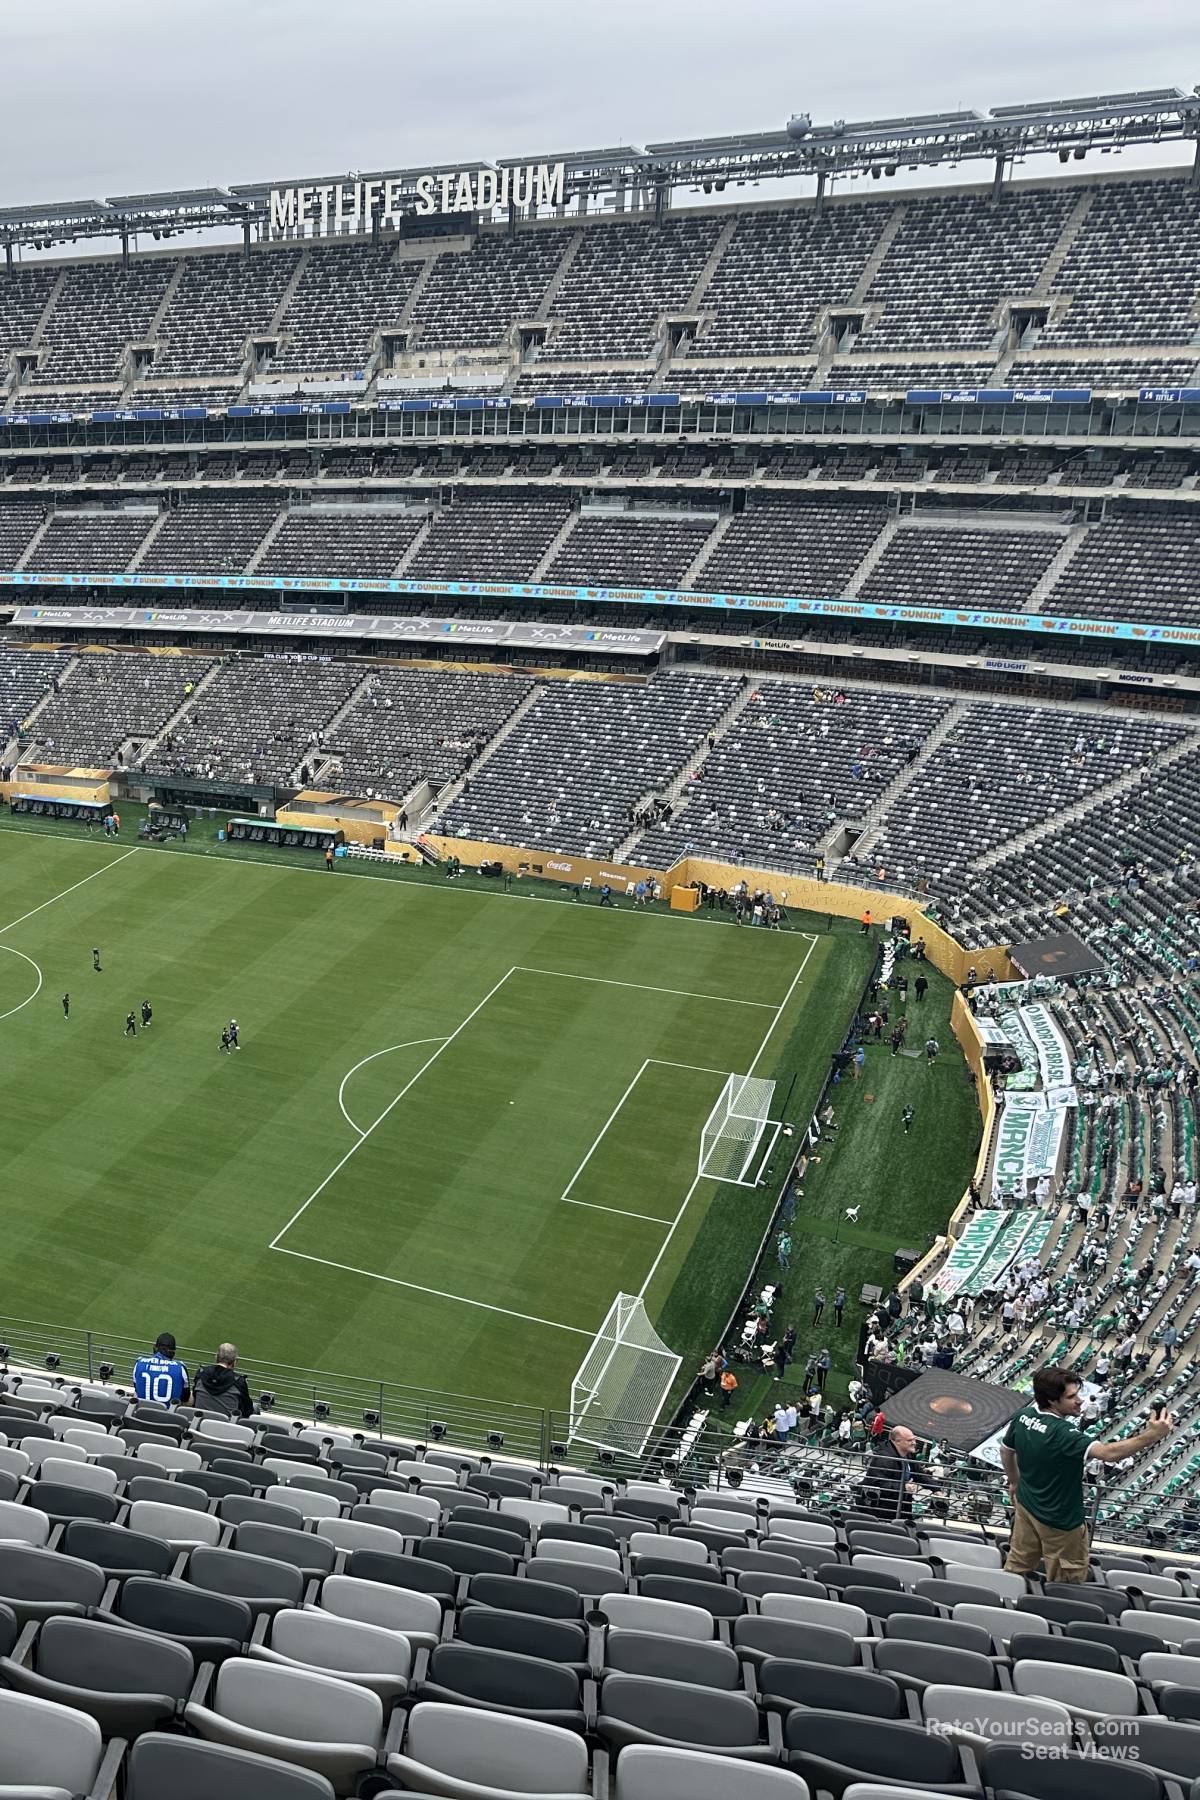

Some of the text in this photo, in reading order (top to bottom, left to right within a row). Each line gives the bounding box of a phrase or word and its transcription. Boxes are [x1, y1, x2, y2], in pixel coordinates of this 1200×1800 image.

[270, 163, 565, 227] METLIFE STADIUM
[543, 588, 578, 597] DUNKIN'
[608, 590, 646, 599] DUNKIN'
[677, 594, 716, 604] DUNKIN'
[748, 599, 789, 609] DUNKIN'
[823, 603, 865, 613] DUNKIN'
[42, 610, 72, 618] MetLife
[901, 609, 944, 620] DUNKIN'
[267, 616, 354, 628] METLIFE STADIUM
[983, 615, 1030, 626] DUNKIN'
[457, 625, 494, 633] MetLife
[1070, 623, 1119, 634] DUNKIN'
[601, 633, 641, 642] MetLife
[765, 641, 790, 649] MetLife
[986, 660, 1027, 671] BUD LIGHT
[1118, 674, 1154, 684] MOODY'S
[600, 871, 626, 880] Hisense
[1031, 1013, 1054, 1039] MAIOR
[1042, 1040, 1061, 1052] DO
[1045, 1053, 1064, 1083] BRASIL
[141, 1372, 173, 1402] 10
[1019, 1414, 1048, 1434] crefisa
